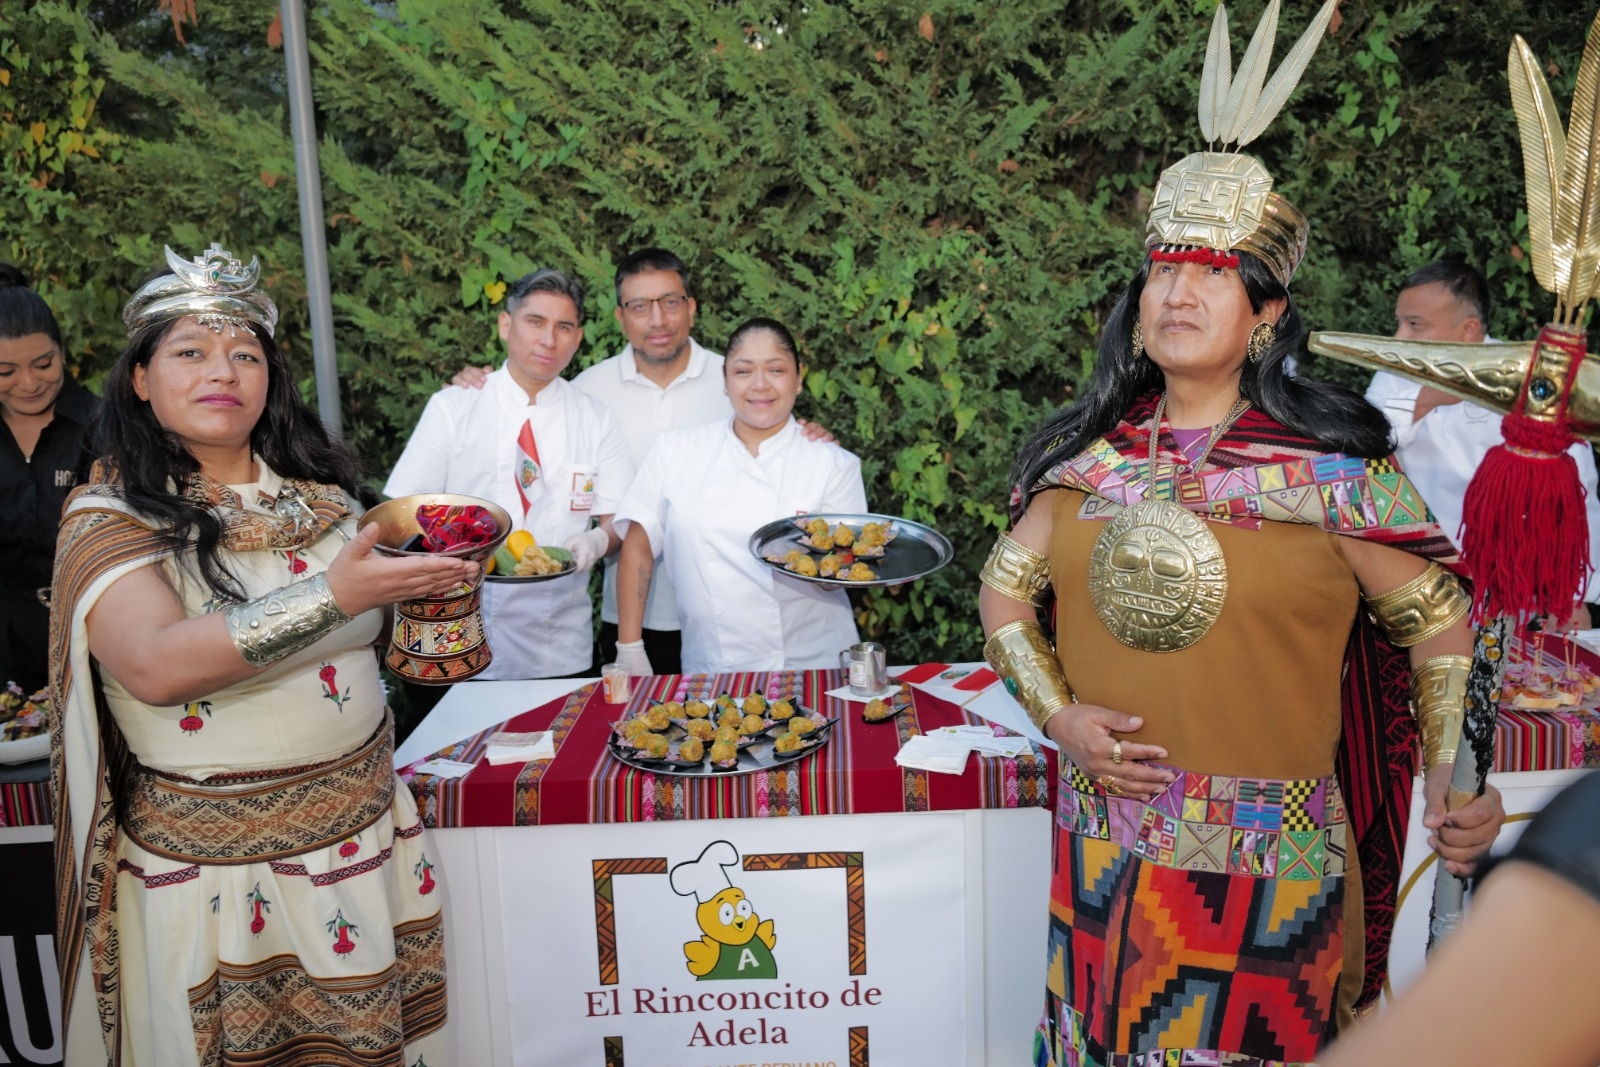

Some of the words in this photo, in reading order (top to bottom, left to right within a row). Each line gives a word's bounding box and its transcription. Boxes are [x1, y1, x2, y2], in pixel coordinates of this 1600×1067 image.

[737, 948, 760, 971] A
[584, 988, 622, 1018] El
[632, 983, 830, 1014] Rinconcito
[840, 979, 882, 1007] de
[686, 1017, 789, 1047] Adela
